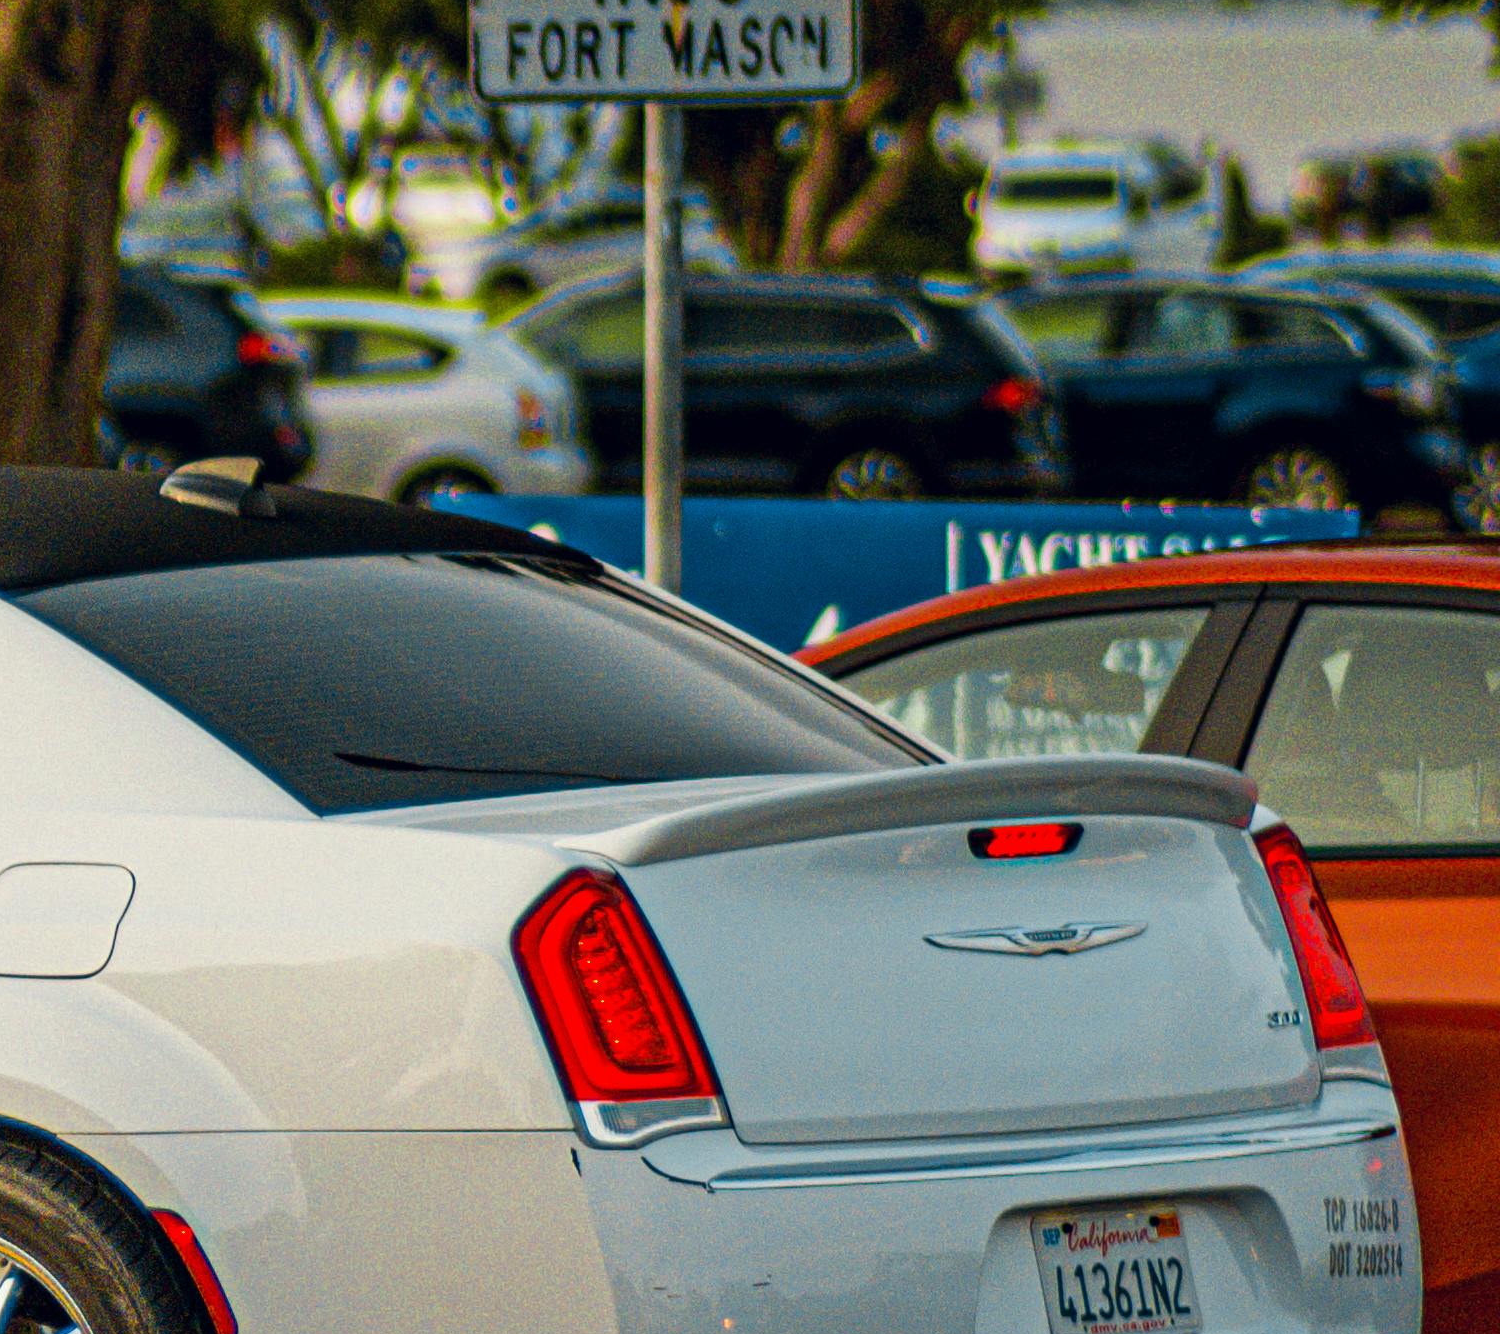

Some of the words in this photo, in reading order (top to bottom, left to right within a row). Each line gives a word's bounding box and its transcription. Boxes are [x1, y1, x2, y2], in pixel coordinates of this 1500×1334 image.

[506, 20, 635, 81] FORT
[978, 531, 1149, 583] YACHT
[1323, 1197, 1347, 1234] TCP
[1042, 1227, 1061, 1246] SEP
[1067, 1219, 1153, 1257] California
[1329, 1242, 1352, 1279] DOT
[1056, 1255, 1191, 1324] 41361N2
